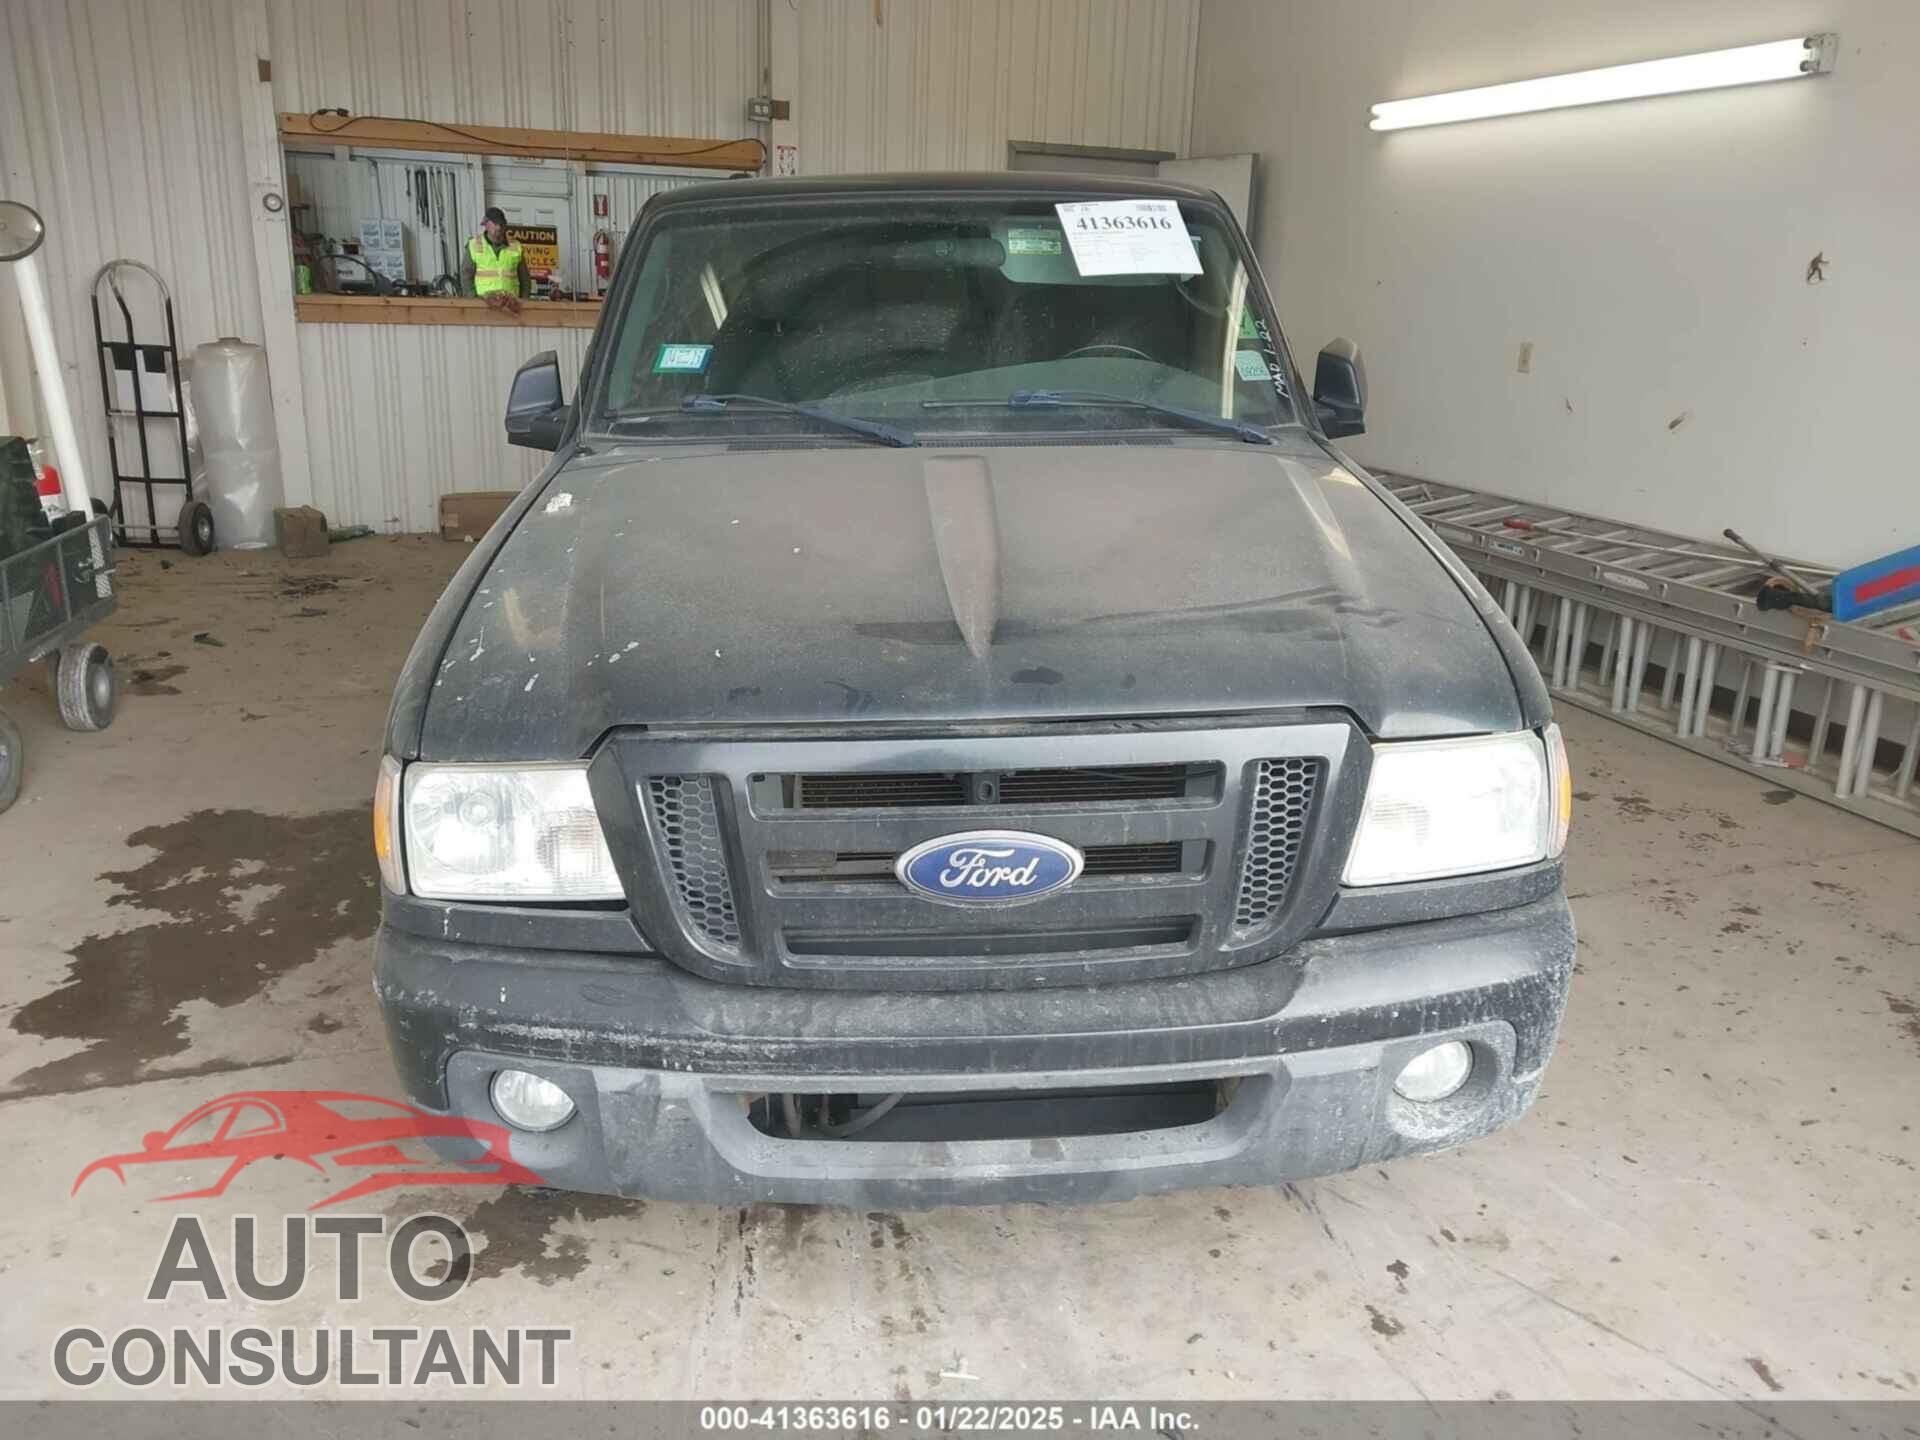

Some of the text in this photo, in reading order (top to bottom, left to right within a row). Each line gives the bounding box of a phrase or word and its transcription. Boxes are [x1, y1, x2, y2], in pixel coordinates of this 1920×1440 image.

[1076, 216, 1172, 230] 41363616
[505, 229, 555, 241] CAUTION
[939, 849, 1039, 887] Ford
